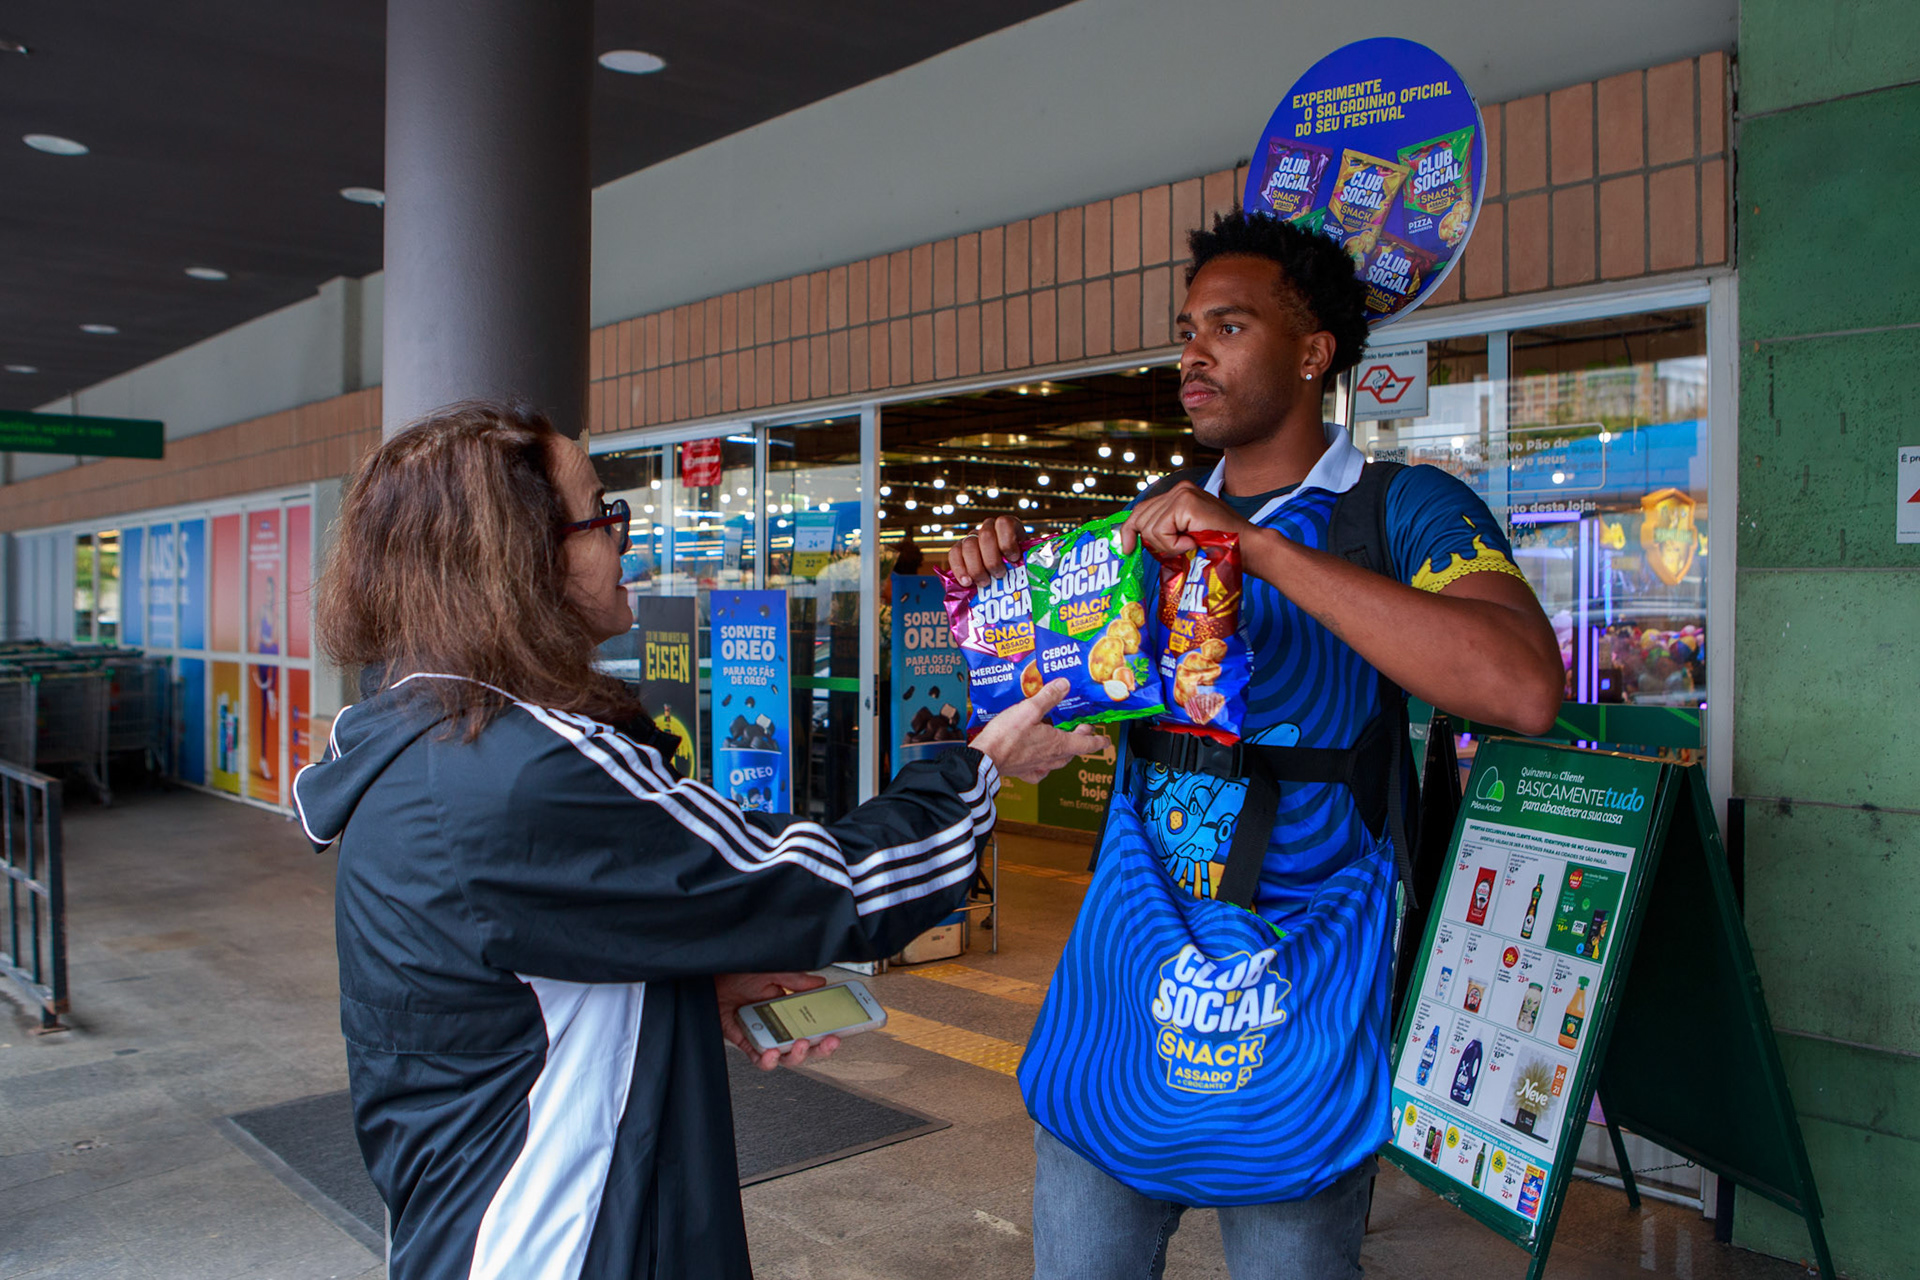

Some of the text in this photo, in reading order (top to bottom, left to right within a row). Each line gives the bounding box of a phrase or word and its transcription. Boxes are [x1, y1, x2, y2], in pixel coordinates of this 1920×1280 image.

[1293, 78, 1382, 109] EXPERIMENTE
[1304, 81, 1452, 121] O SALGADINHO OFICIAL
[1295, 106, 1405, 138] DO SEU FESTIVAL
[1278, 156, 1311, 175] CLUB
[1418, 148, 1453, 176] CLUB
[1349, 171, 1385, 192] CLUB
[1271, 190, 1301, 204] SNACK
[1421, 185, 1455, 204] SNACK
[1341, 205, 1372, 222] SNACK
[1408, 217, 1433, 231] PIZZA
[1376, 252, 1411, 276] CLUB
[1526, 439, 1550, 450] Pão
[1553, 437, 1570, 449] de
[1537, 454, 1566, 465] seus
[1901, 453, 1920, 464] É pr
[1529, 501, 1565, 513] desta
[1568, 499, 1597, 514] loja:
[1058, 537, 1110, 577] CLUB
[977, 564, 1029, 603] CLUB
[1059, 594, 1112, 621] SNACK
[903, 611, 948, 628] SORVE
[1070, 614, 1100, 629] ASSADO
[720, 625, 776, 640] SORVETE
[721, 639, 776, 661] OREO
[1000, 637, 1031, 651] ASSADO
[1042, 642, 1081, 661] CEBOLA
[646, 642, 690, 684] EISEN
[905, 655, 931, 667] PARA
[931, 654, 944, 664] OS
[1043, 655, 1082, 674] E SALSA
[722, 666, 746, 676] PARA
[746, 666, 758, 676] OS
[914, 664, 953, 676] DE OREO
[731, 675, 767, 686] DE OREO
[971, 672, 1014, 687] BARBECUE
[729, 766, 773, 786] OREO
[1521, 766, 1552, 779] Quinzena
[1559, 770, 1585, 783] Cliente
[1081, 785, 1108, 802] hoje
[1517, 779, 1645, 813] BASICAMENTE tudo
[1520, 800, 1624, 825] para abastecer a sua casa
[1174, 944, 1277, 991] CLUB
[1160, 1031, 1260, 1067] SNACK
[1174, 1066, 1233, 1083] ASSADO
[1555, 1070, 1565, 1080] 24
[1182, 1079, 1227, 1090] CROCANTE!
[1516, 1078, 1549, 1106] Neve
[1552, 1085, 1561, 1095] 21
